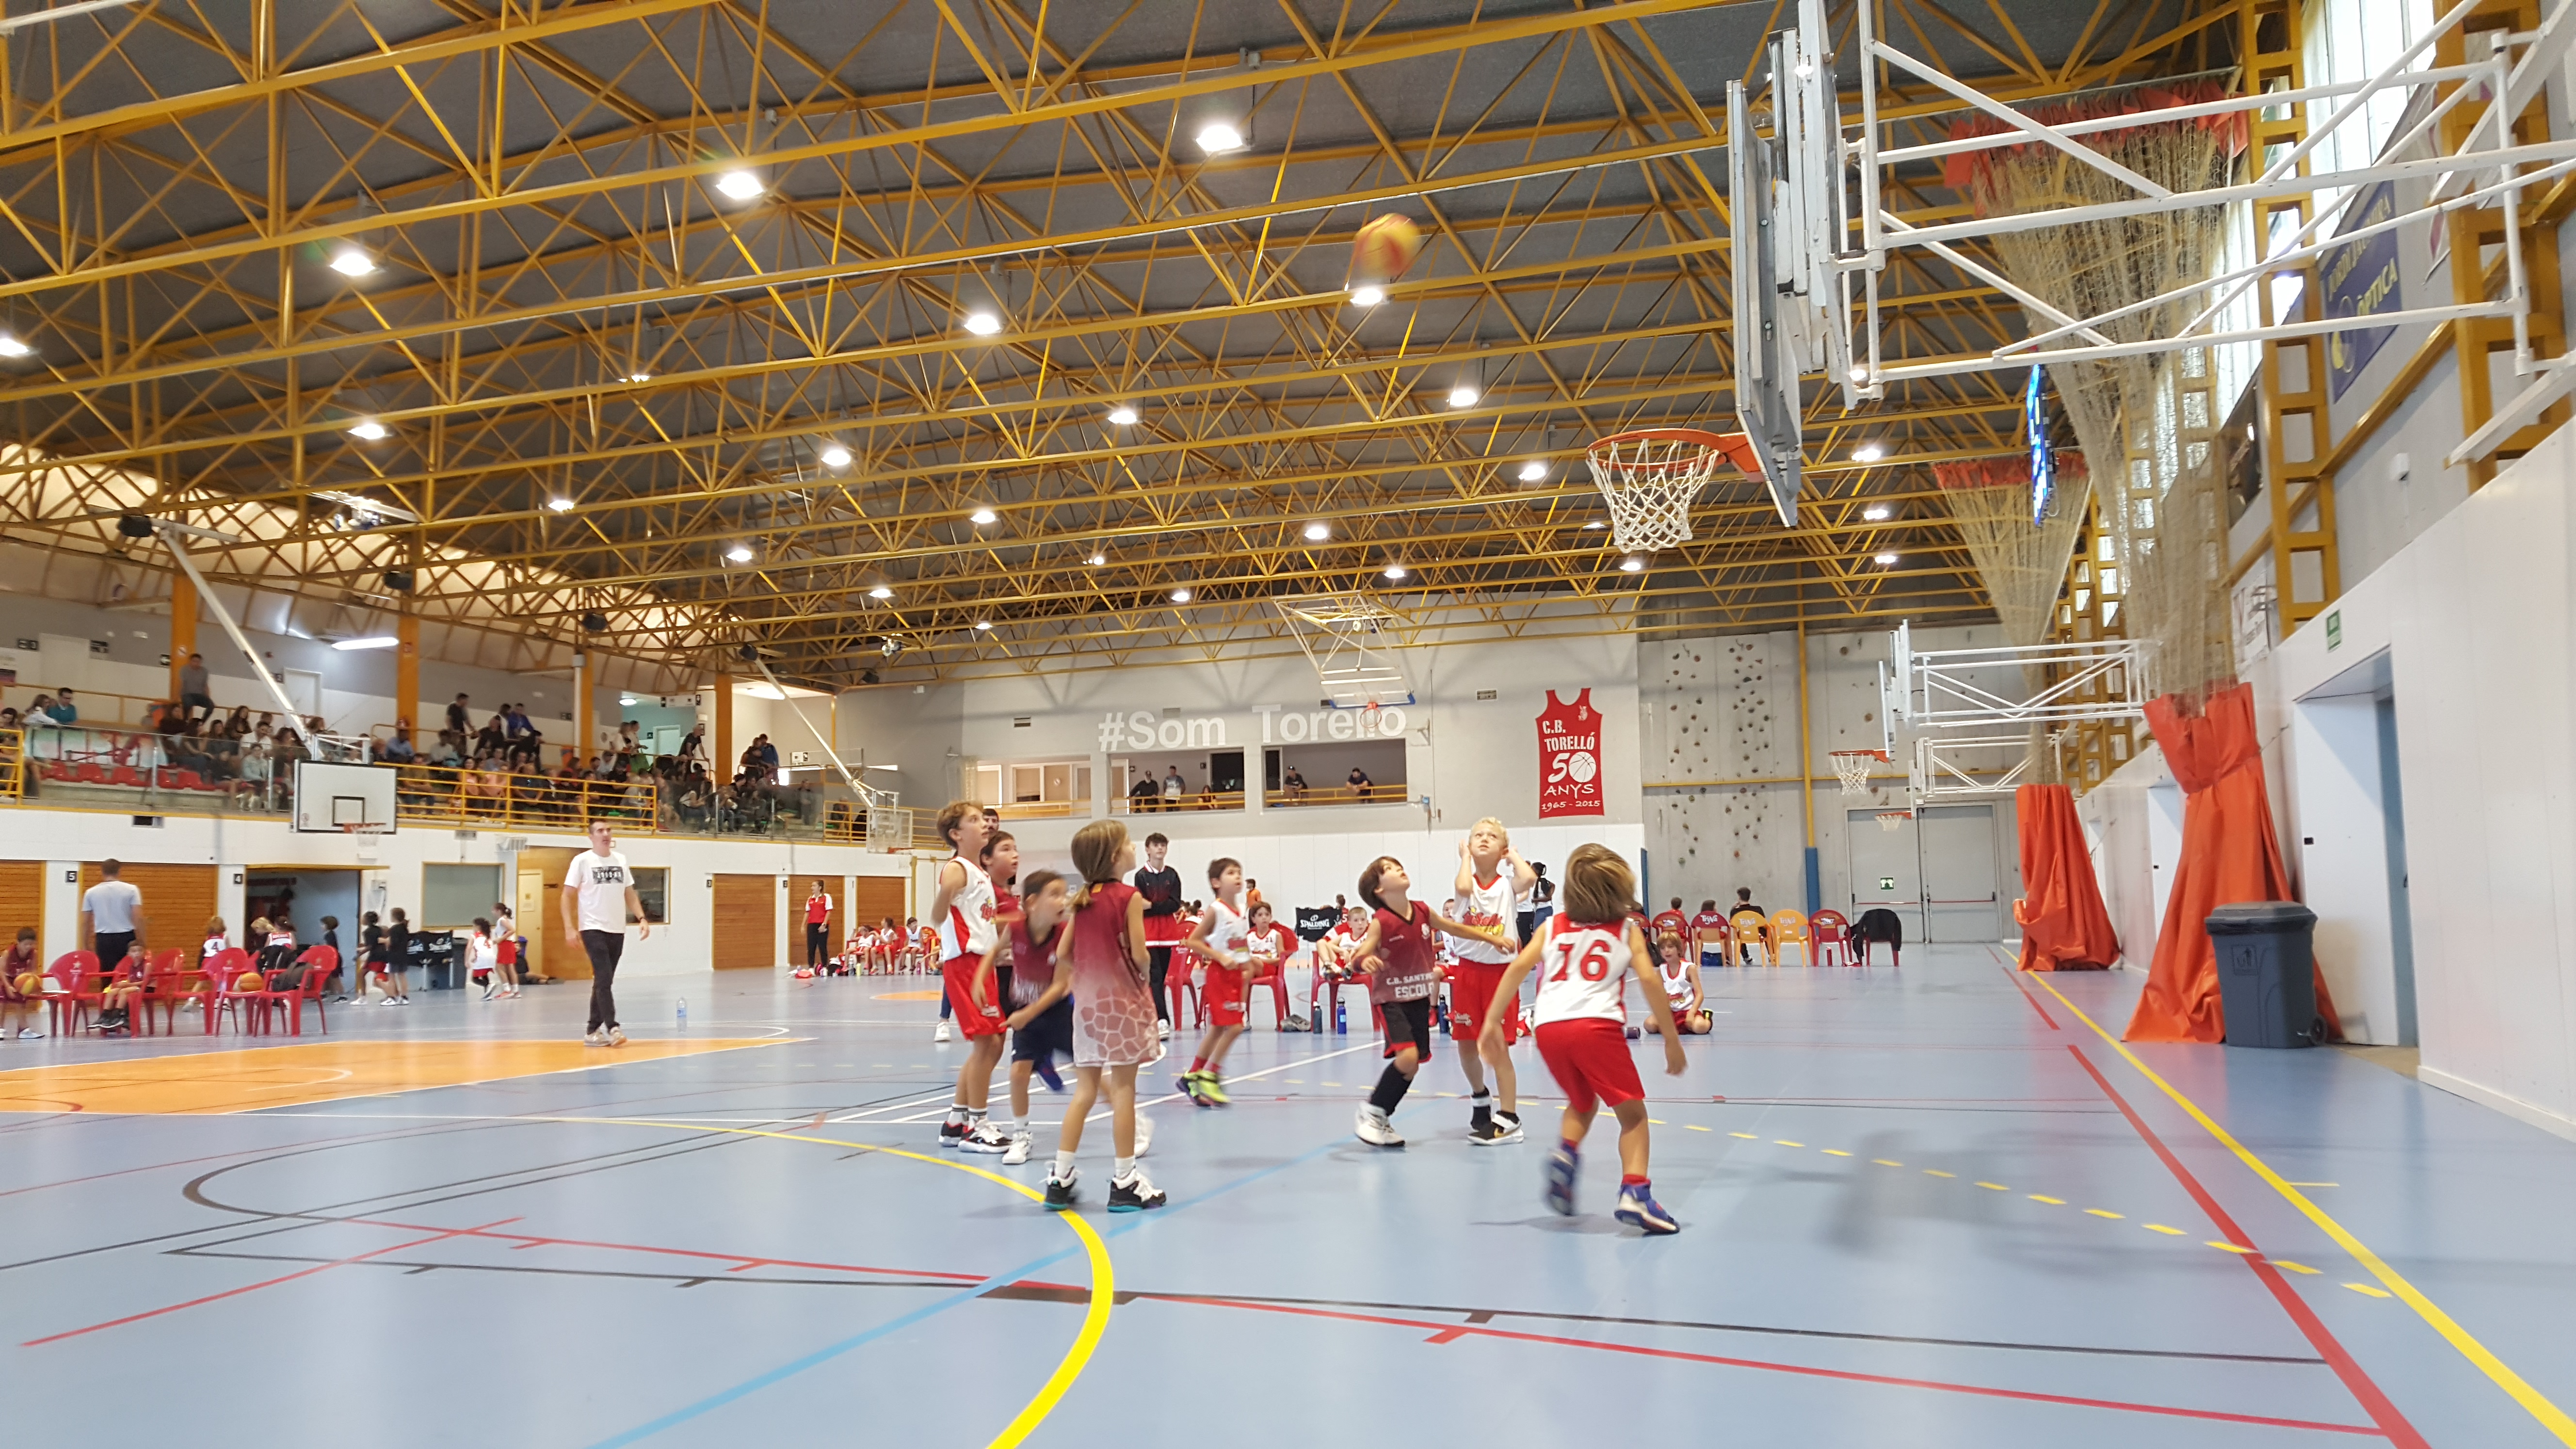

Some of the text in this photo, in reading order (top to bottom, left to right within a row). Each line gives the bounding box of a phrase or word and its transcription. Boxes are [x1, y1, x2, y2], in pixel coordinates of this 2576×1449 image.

[1098, 710, 1226, 752] #Som
[1542, 719, 1566, 734] C.B.
[1544, 732, 1595, 752] TORELLÓ
[1548, 751, 1596, 783] 50
[1544, 784, 1594, 799] ANYS
[1541, 801, 1567, 813] 1965
[1575, 800, 1601, 808] 2015
[69, 872, 75, 881] 5
[1300, 918, 1330, 928] SPALDING
[1550, 939, 1611, 982] 16
